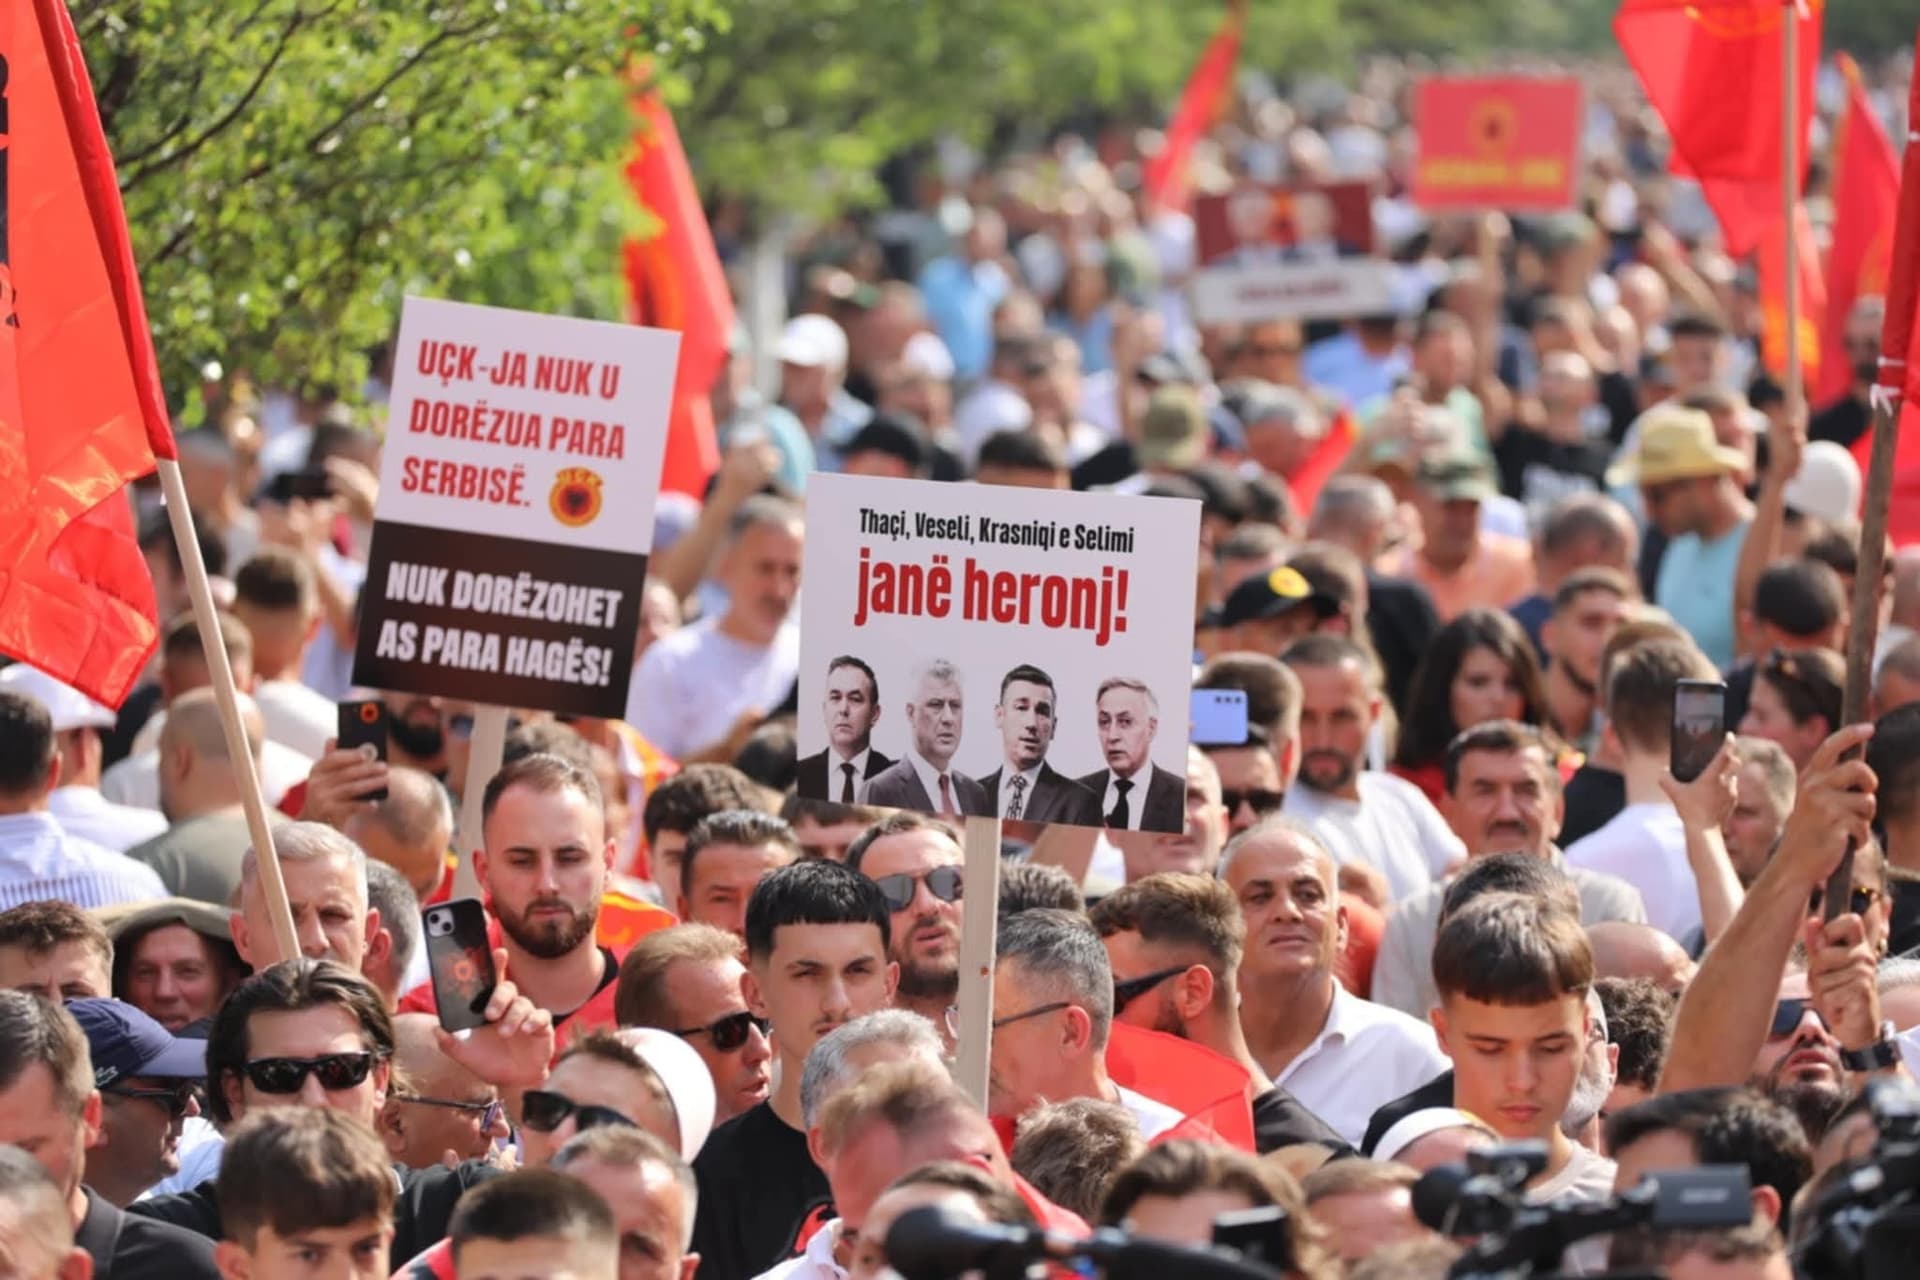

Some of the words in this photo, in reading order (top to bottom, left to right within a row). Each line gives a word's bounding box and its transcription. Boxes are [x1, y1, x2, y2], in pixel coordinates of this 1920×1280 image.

[417, 339, 528, 389] UÇK-JA
[534, 356, 596, 396] NUK
[600, 365, 621, 400] U
[409, 398, 541, 449] DORËZUA
[549, 417, 625, 460] PARA
[401, 456, 531, 508] SERBISË.
[859, 508, 911, 542] Thaçi,
[915, 511, 975, 545] Veseli,
[979, 517, 1056, 552] Krasniqi
[1058, 525, 1070, 549] e
[1074, 523, 1135, 553] Selimi
[385, 561, 449, 606] NUK
[451, 572, 623, 629] DORËZOHET
[854, 547, 952, 627] janë
[962, 557, 1129, 647] heronj!
[376, 620, 417, 662] AS
[421, 626, 499, 673] PARA
[504, 637, 613, 687] HAGËS!
